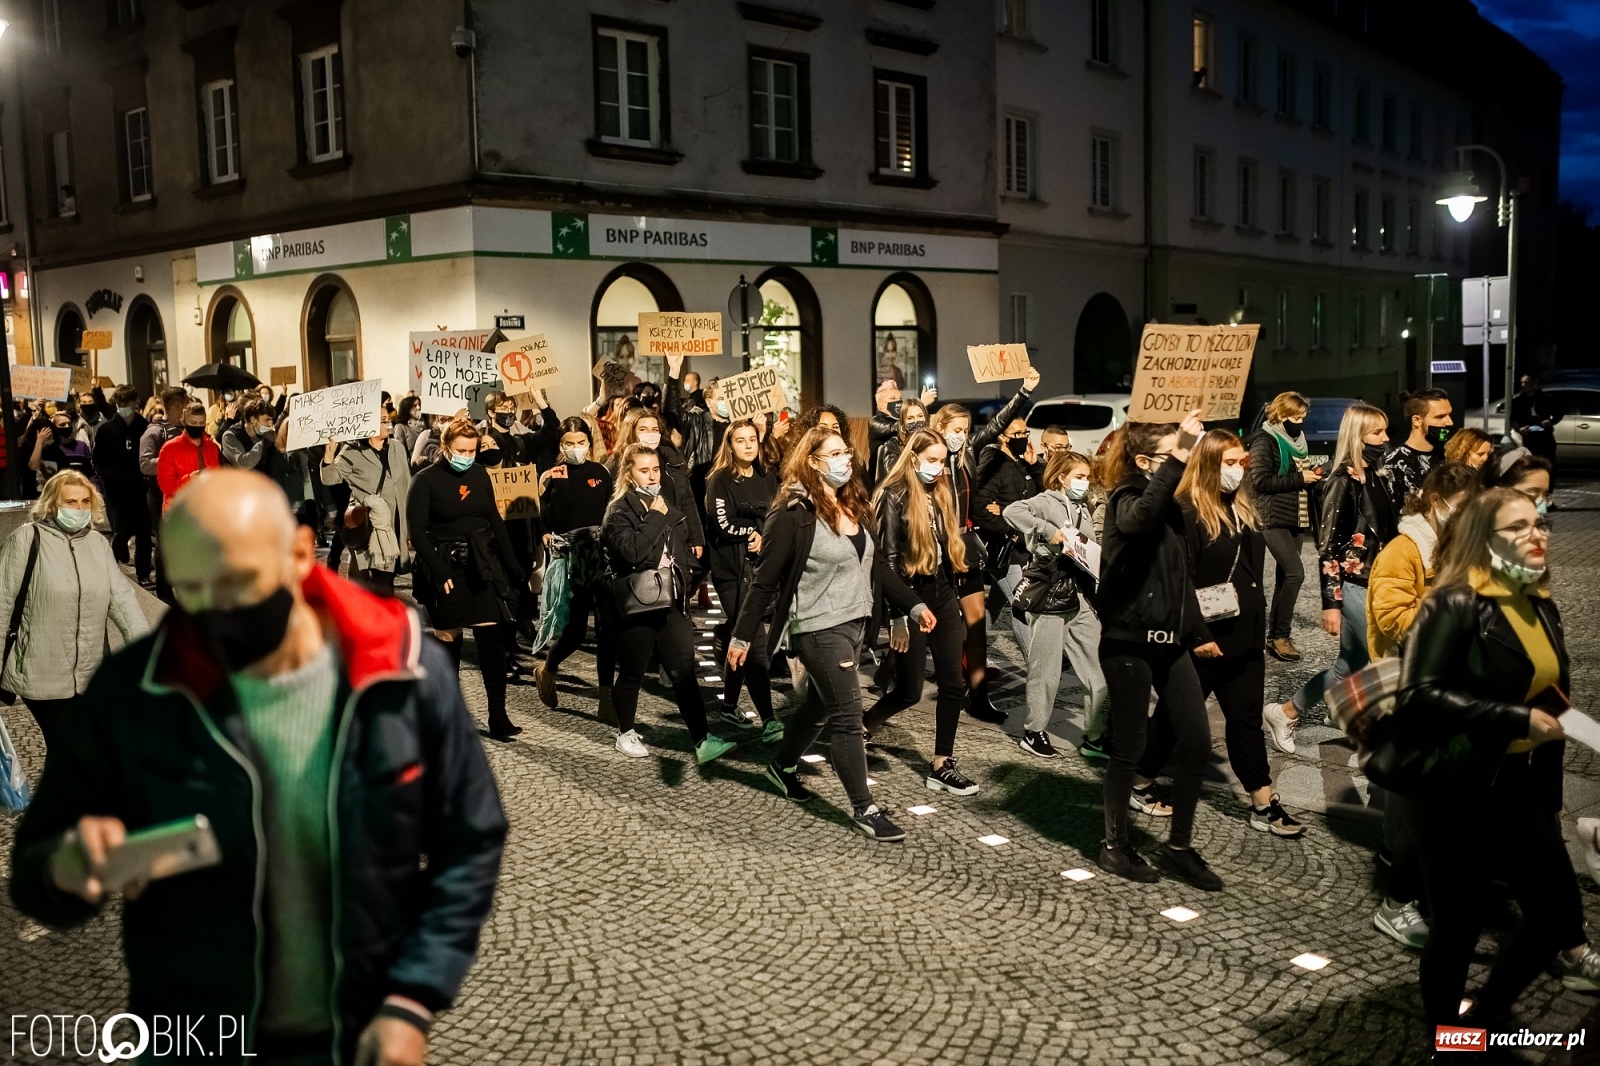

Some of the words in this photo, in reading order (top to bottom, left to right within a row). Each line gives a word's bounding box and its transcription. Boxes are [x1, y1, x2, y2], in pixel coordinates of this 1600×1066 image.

[606, 228, 639, 243] BNP
[643, 230, 708, 247] PARIBAS
[262, 246, 280, 261] BNP
[283, 240, 325, 258] PARIBAS
[851, 241, 875, 254] BNP
[878, 243, 926, 257] PARIBAS
[660, 316, 688, 328] JAREK
[690, 318, 719, 331] UKRADŁ
[412, 341, 423, 354] W
[650, 341, 679, 352] PRAWA
[1143, 333, 1182, 351] GDYBY
[1186, 334, 1201, 352] TO
[426, 349, 459, 366] ŁAPY
[535, 356, 547, 364] DO
[429, 366, 446, 379] OD
[456, 368, 498, 388] MOJEJ
[1151, 377, 1165, 388] TO
[1168, 375, 1204, 389] ABORCJ
[294, 391, 325, 410] MARS
[331, 388, 344, 398] OD
[429, 382, 481, 402] MACICY
[332, 395, 364, 408] SRAM
[297, 414, 313, 427] PIS
[321, 410, 336, 420] OD
[326, 417, 336, 427] W
[313, 423, 360, 445] JEBANY
[356, 430, 376, 438] ELO
[496, 498, 538, 514] EDOM
[728, 525, 757, 536] ON'T
[1013, 577, 1031, 602] PUMA
